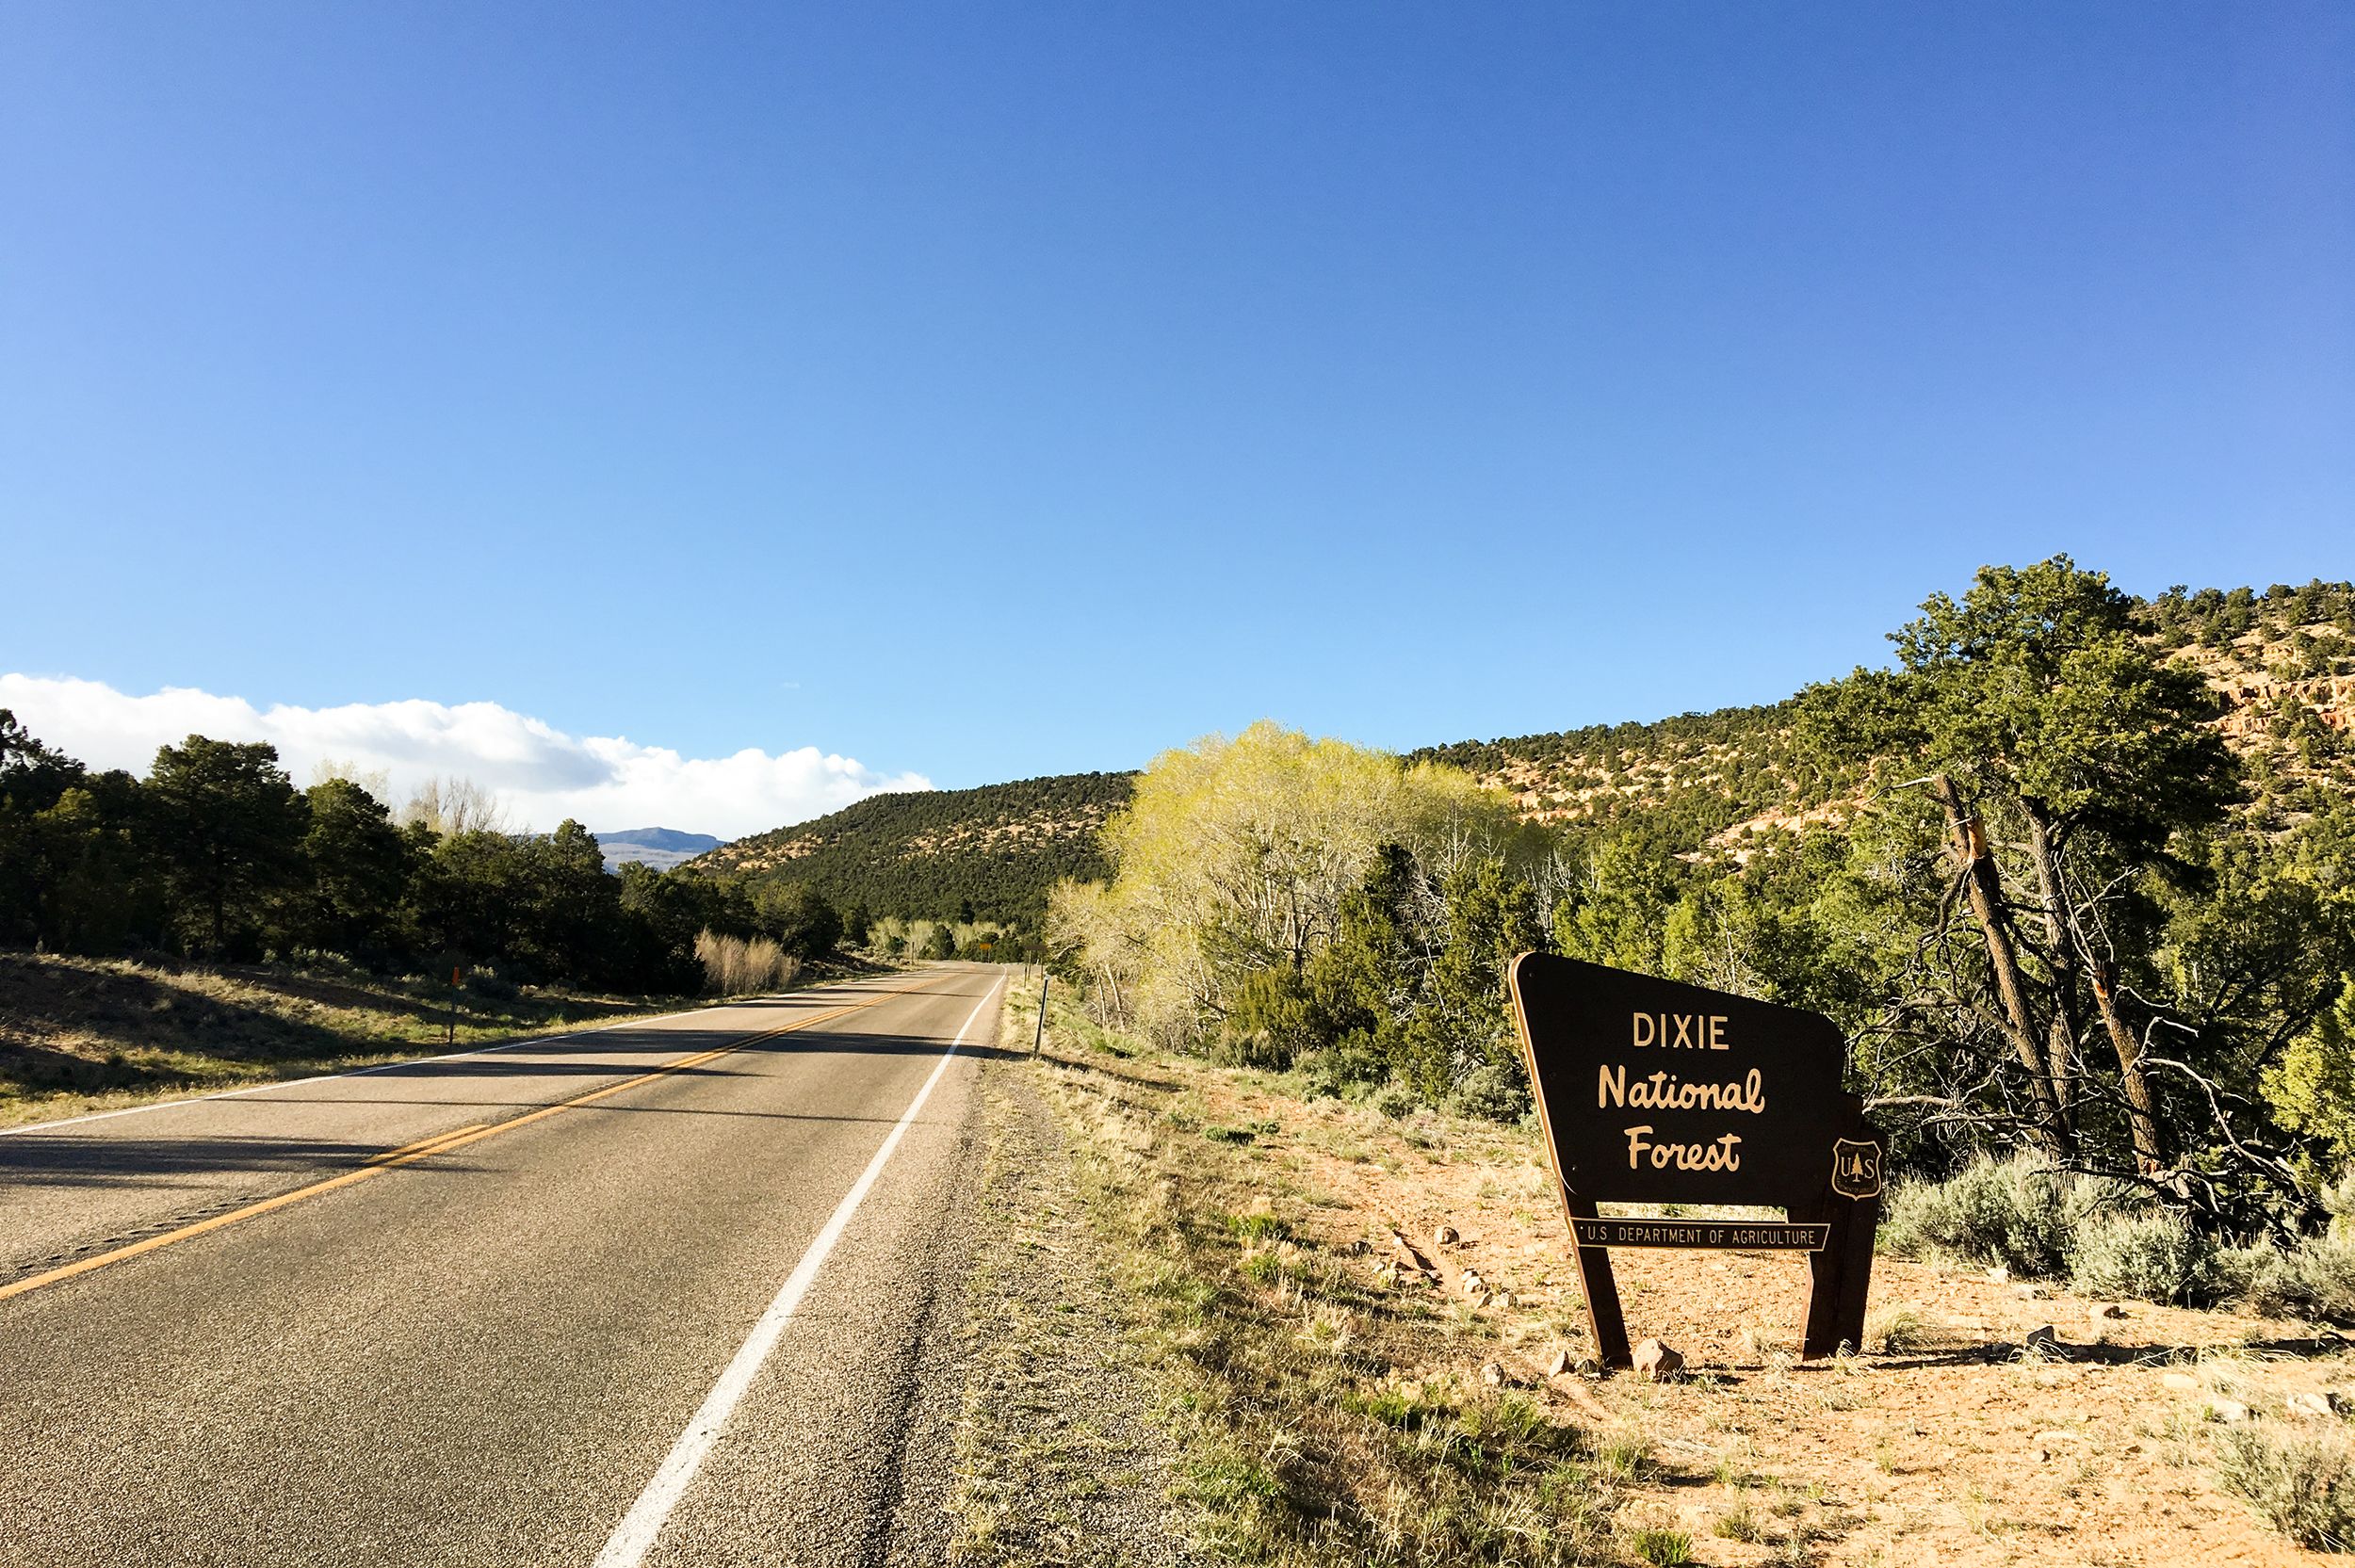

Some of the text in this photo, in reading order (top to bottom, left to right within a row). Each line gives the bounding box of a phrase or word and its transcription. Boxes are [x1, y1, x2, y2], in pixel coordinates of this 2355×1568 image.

[1633, 1012, 1730, 1050] DIXIE
[1599, 1065, 1765, 1114] National
[1624, 1125, 1743, 1172] Forest
[1618, 1227, 1702, 1243] DEPARTMENT
[1709, 1229, 1725, 1244] OF
[1731, 1229, 1815, 1245] AGRICULTURE
